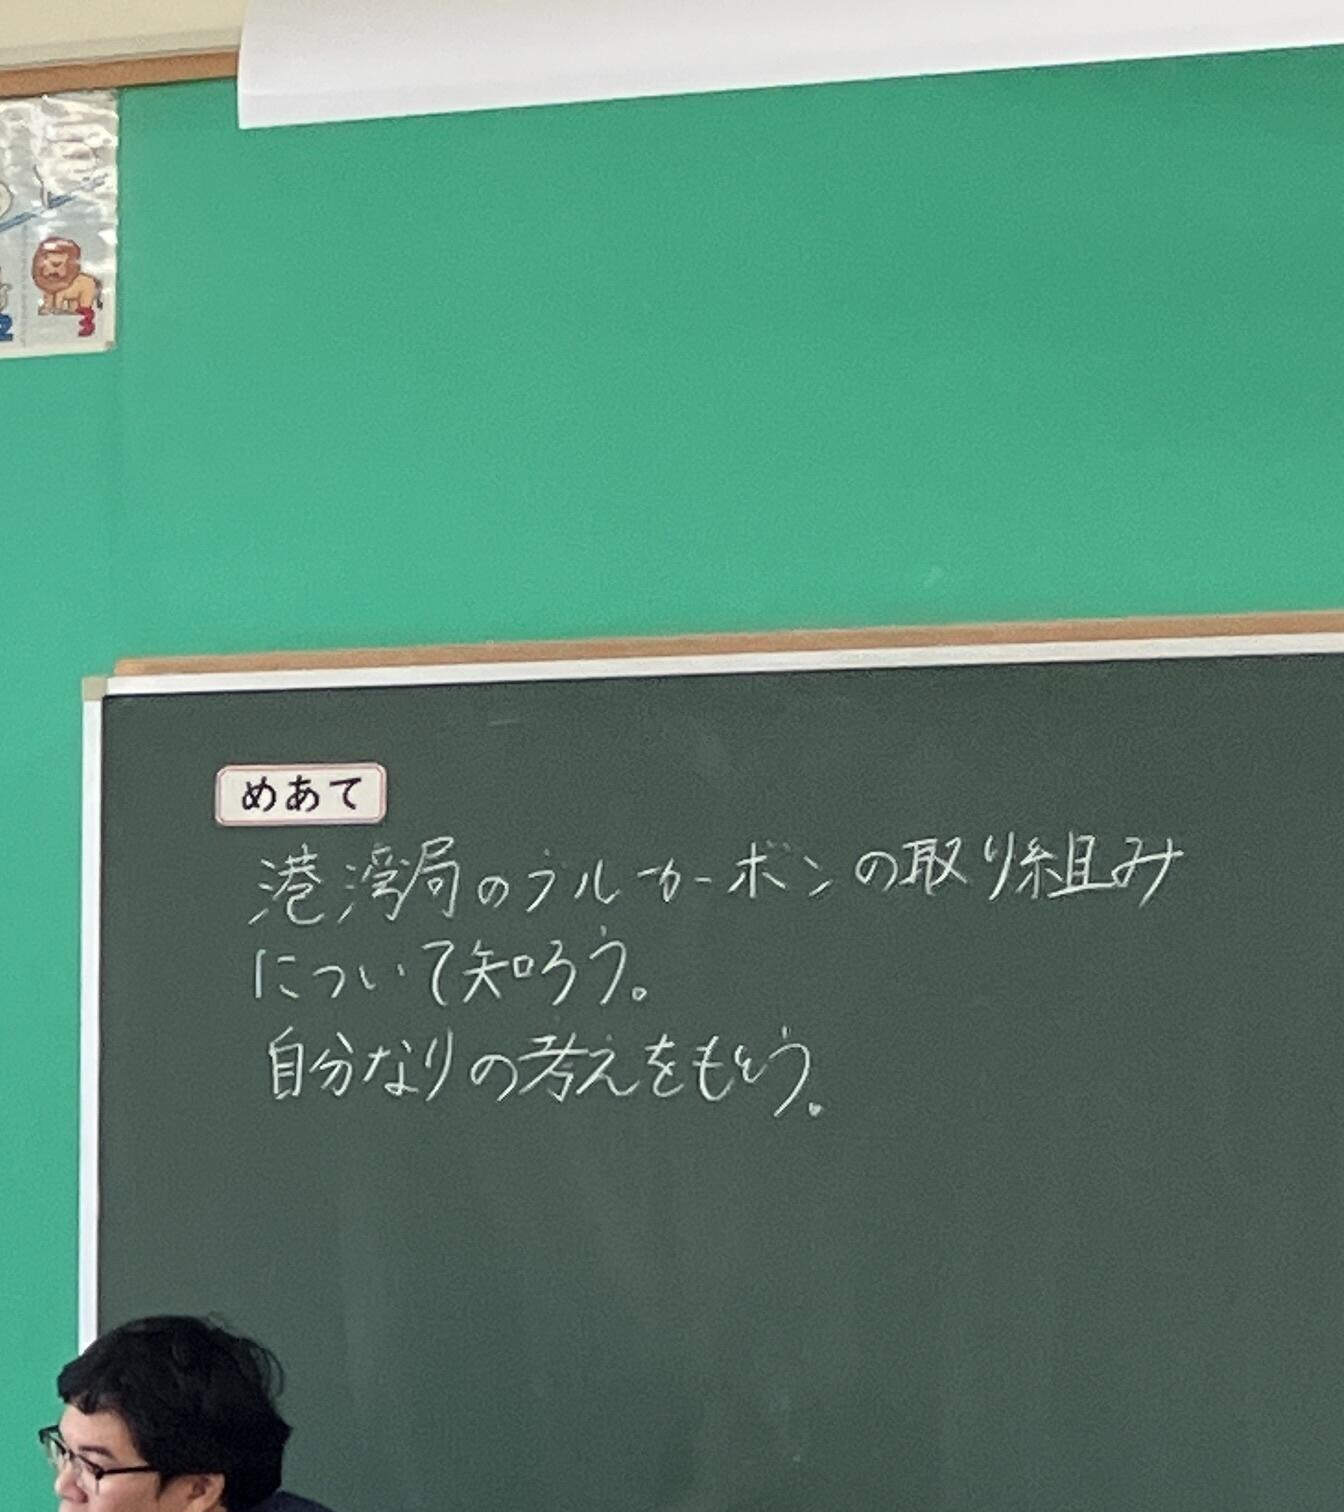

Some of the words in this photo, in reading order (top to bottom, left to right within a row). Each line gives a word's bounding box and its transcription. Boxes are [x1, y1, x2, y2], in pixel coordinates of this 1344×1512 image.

[75, 304, 97, 336] 3
[241, 774, 363, 814] めあて
[254, 924, 648, 1007] について知ろう。
